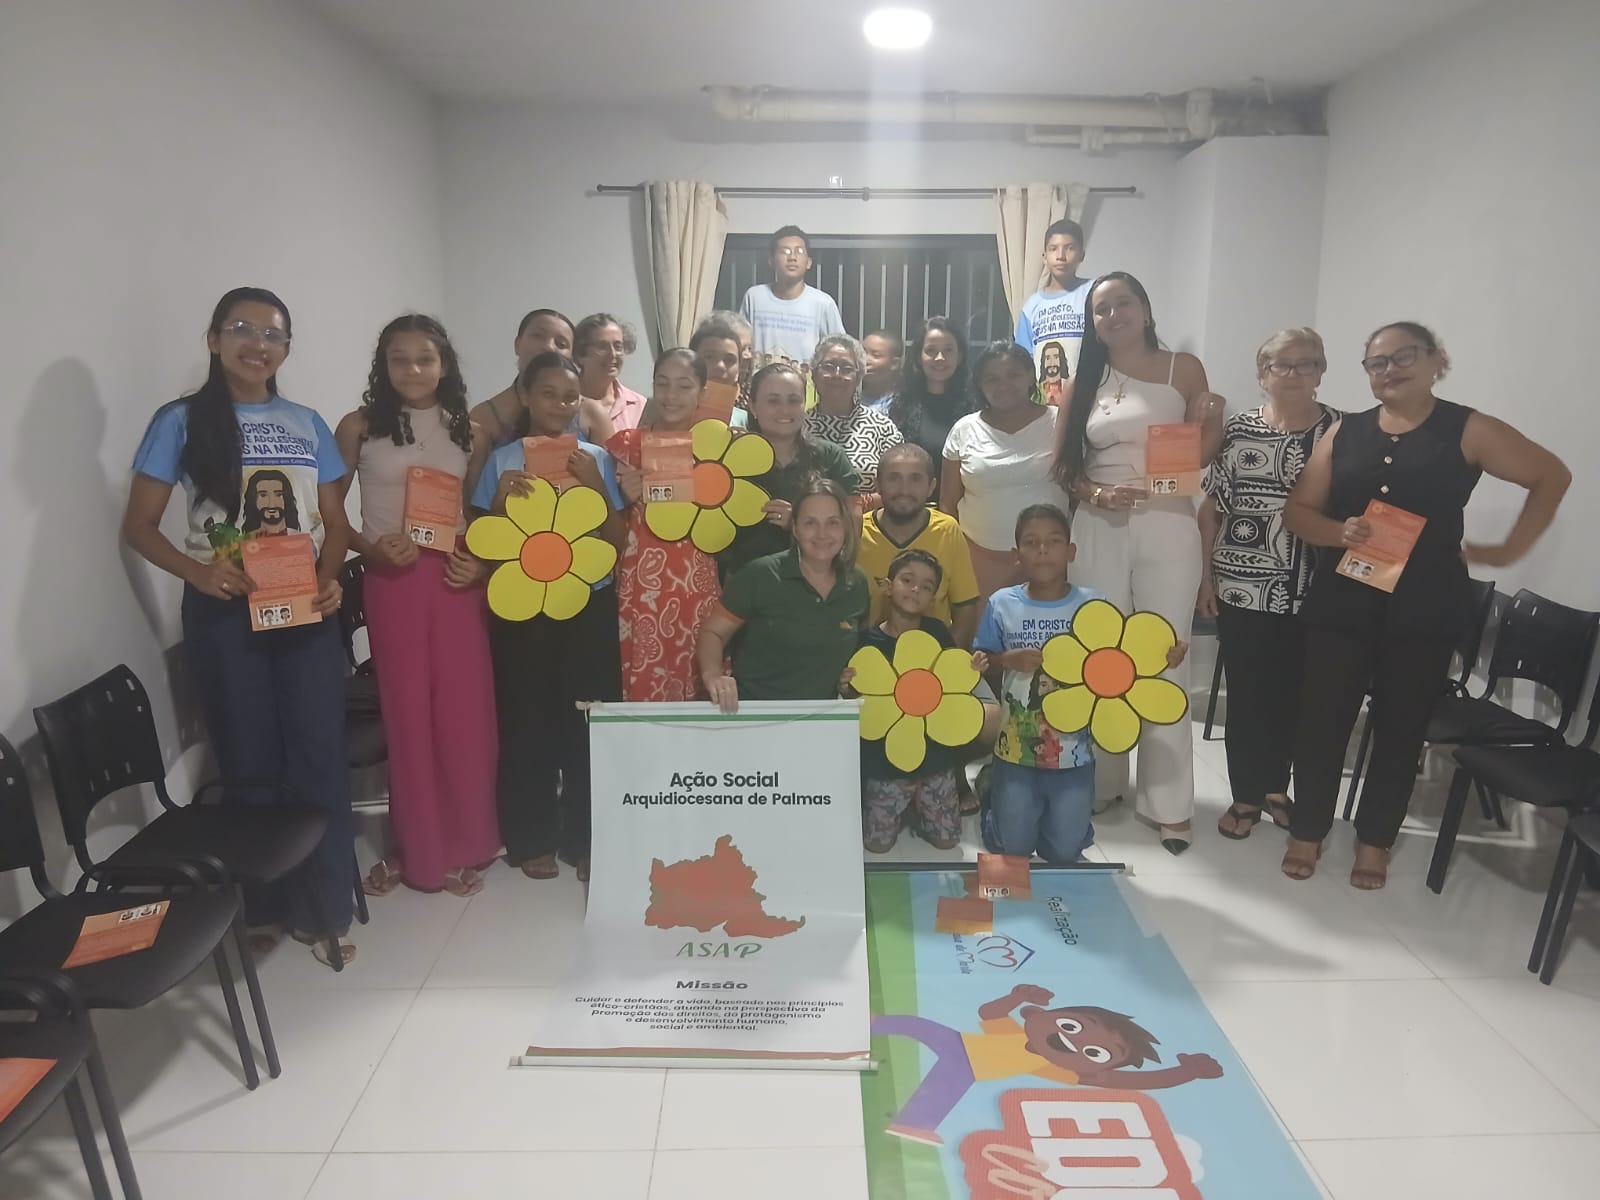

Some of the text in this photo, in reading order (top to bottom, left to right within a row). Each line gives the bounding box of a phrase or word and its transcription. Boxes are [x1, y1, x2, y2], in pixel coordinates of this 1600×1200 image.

[242, 423, 290, 436] CRISTO,
[253, 444, 273, 455] NA
[1022, 619, 1036, 630] EM
[1039, 632, 1043, 640] E
[669, 771, 779, 792] Ação Social
[622, 792, 832, 809] Arquidiocesana de Palmas
[676, 942, 762, 958] ASAP
[676, 980, 748, 990] Missão
[673, 1003, 722, 1011] atuando
[676, 1010, 721, 1018] direitos,
[1020, 1100, 1180, 1200] ED
